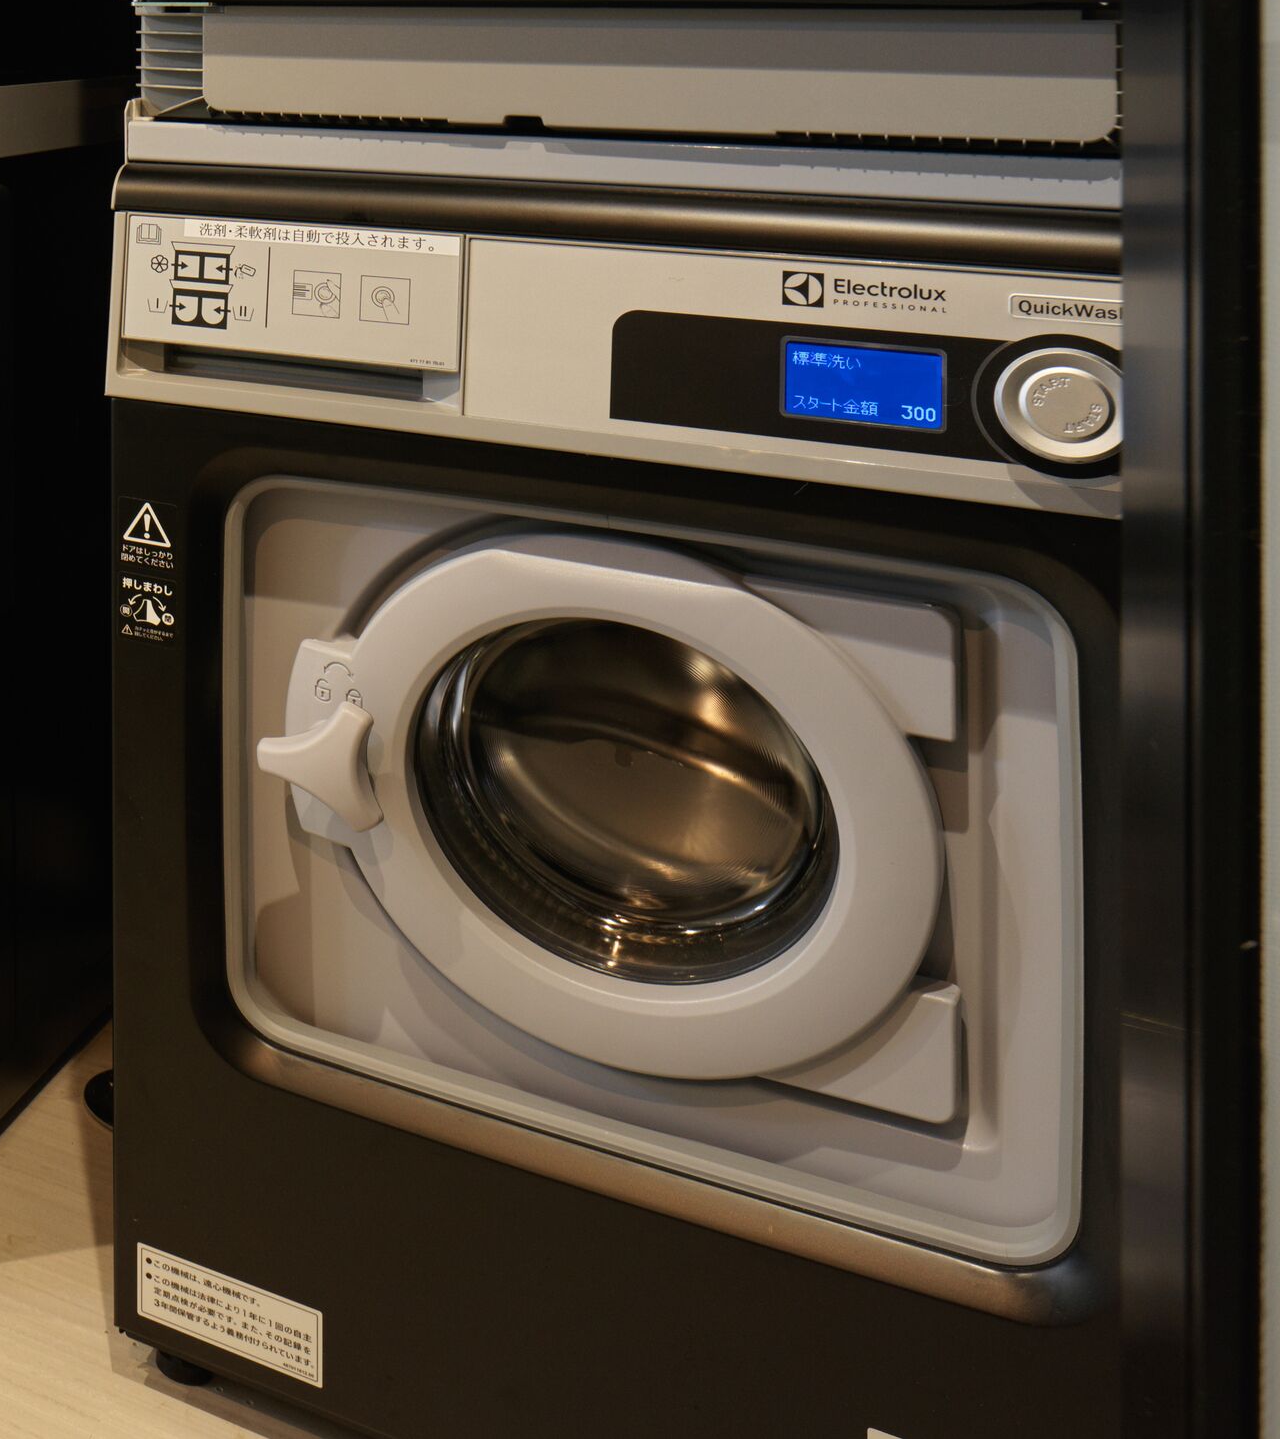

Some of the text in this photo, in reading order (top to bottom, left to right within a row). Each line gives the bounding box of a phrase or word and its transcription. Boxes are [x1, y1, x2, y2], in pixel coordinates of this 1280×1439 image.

[199, 222, 436, 252] 洗剤・柔軟剤は自動で投入されます。
[833, 278, 947, 302] Electrolux
[833, 298, 948, 314] PROFESSIONAL
[792, 350, 861, 370] 標準洗い
[792, 394, 937, 422] スタート金額 300
[120, 552, 174, 569] 閉めてください
[121, 544, 173, 560] ドアはしっかり
[122, 576, 173, 597] 押しまわし
[153, 1259, 261, 1308] この機械は、遠心機械です。
[153, 1286, 312, 1355] 定期点検が必要です。また、その記録を
